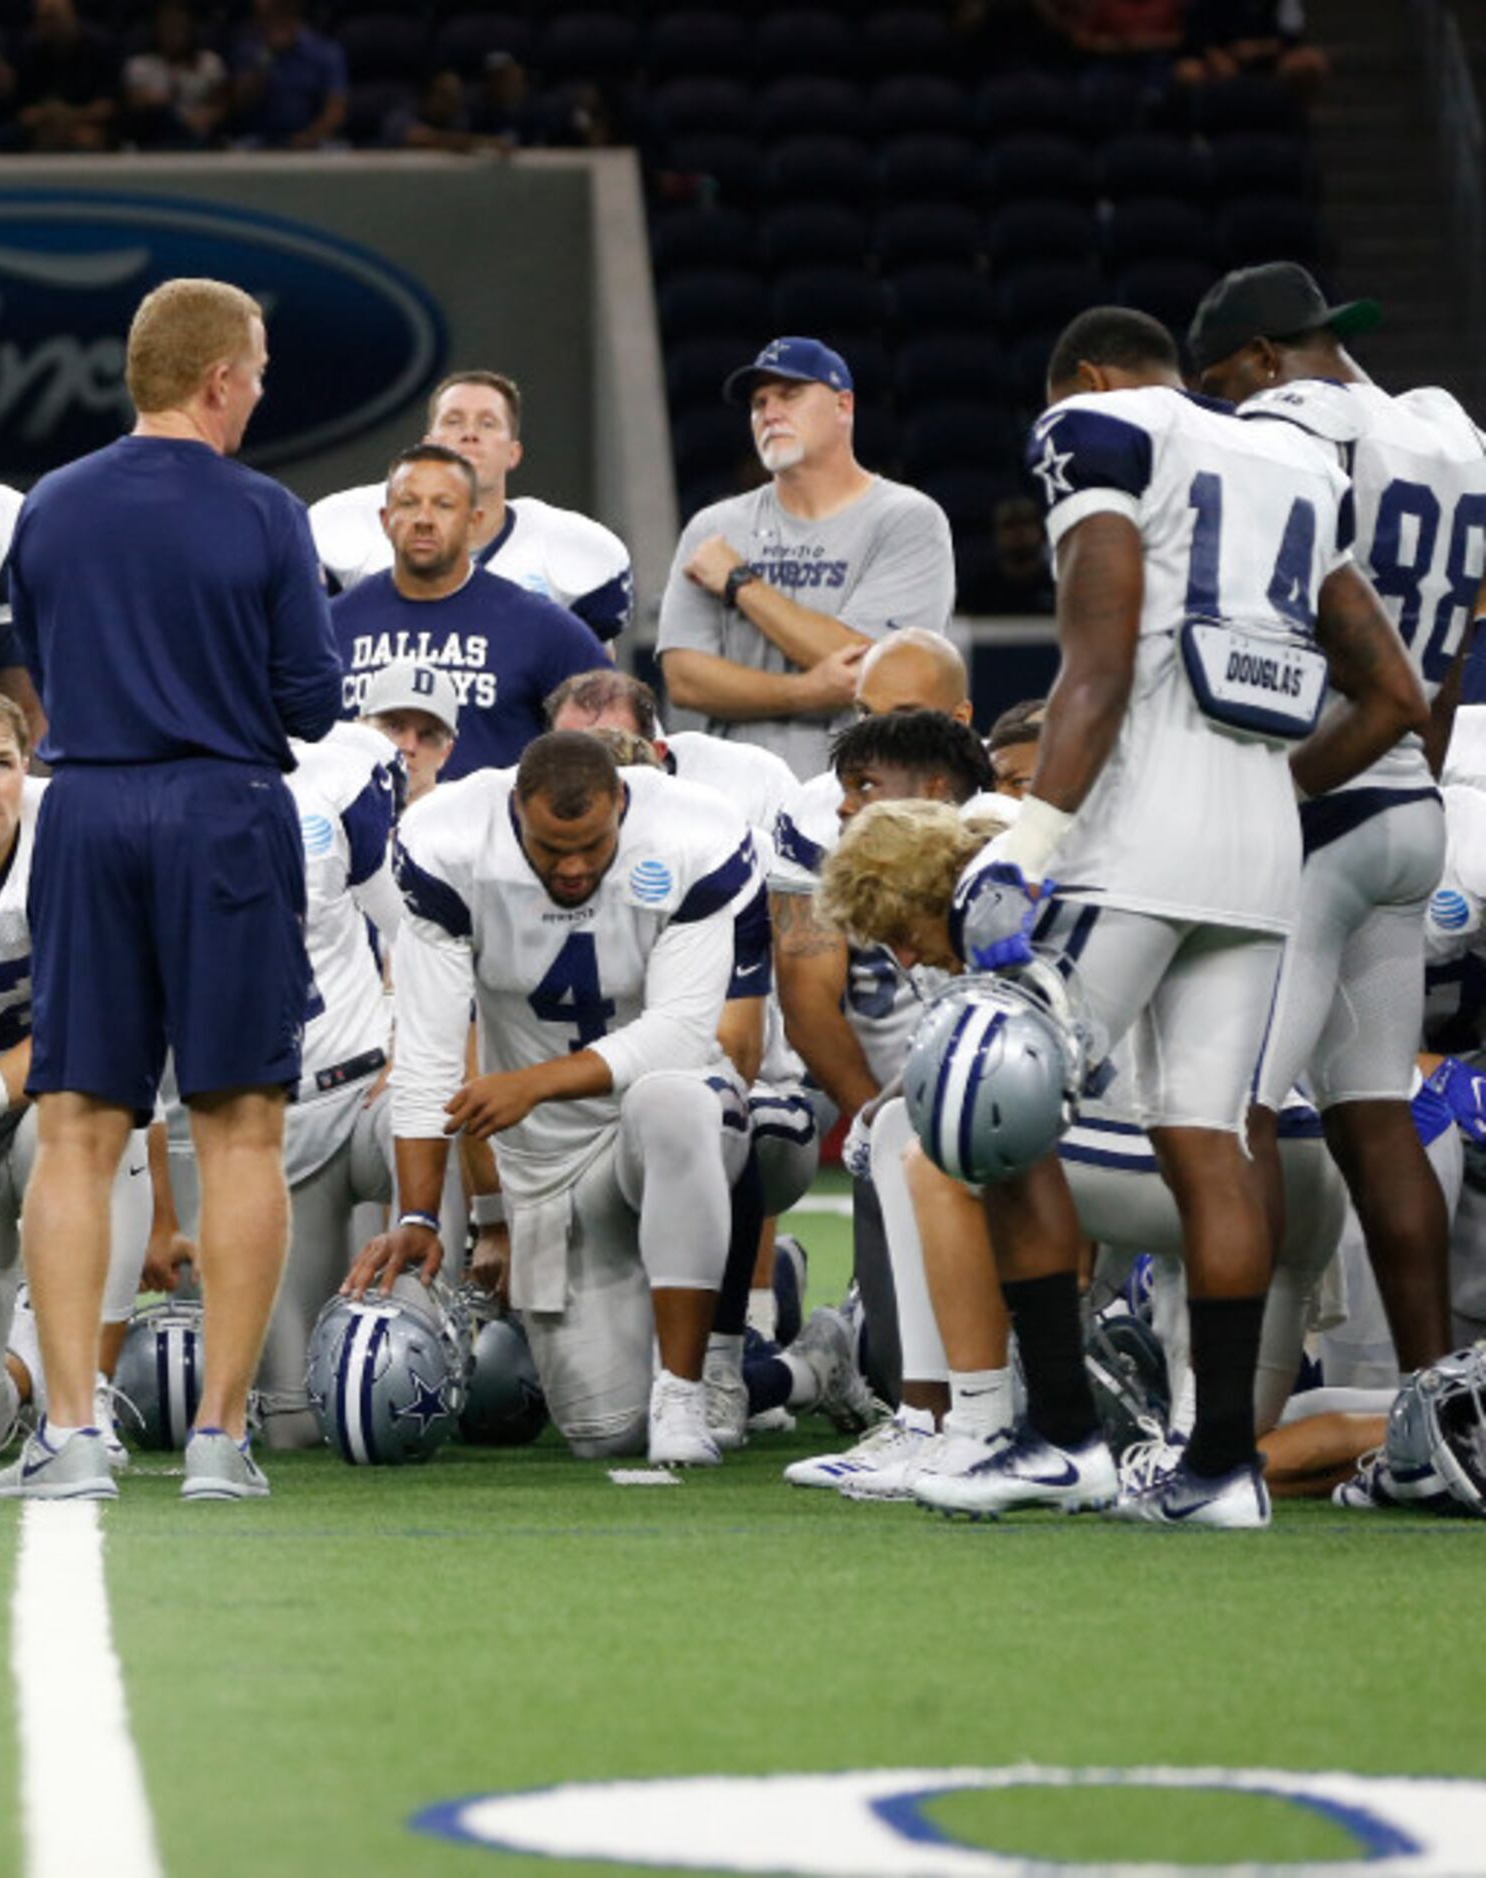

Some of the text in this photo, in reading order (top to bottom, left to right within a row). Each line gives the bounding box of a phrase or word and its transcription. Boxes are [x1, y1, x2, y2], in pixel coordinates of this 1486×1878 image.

[752, 560, 848, 588] WBOYS
[1185, 469, 1317, 637] 14
[1370, 478, 1486, 681] 88
[351, 631, 488, 669] DALLAS
[342, 671, 497, 710] COYS
[412, 668, 435, 696] D
[1225, 651, 1304, 697] DOUGLAS
[527, 931, 616, 1054] 4
